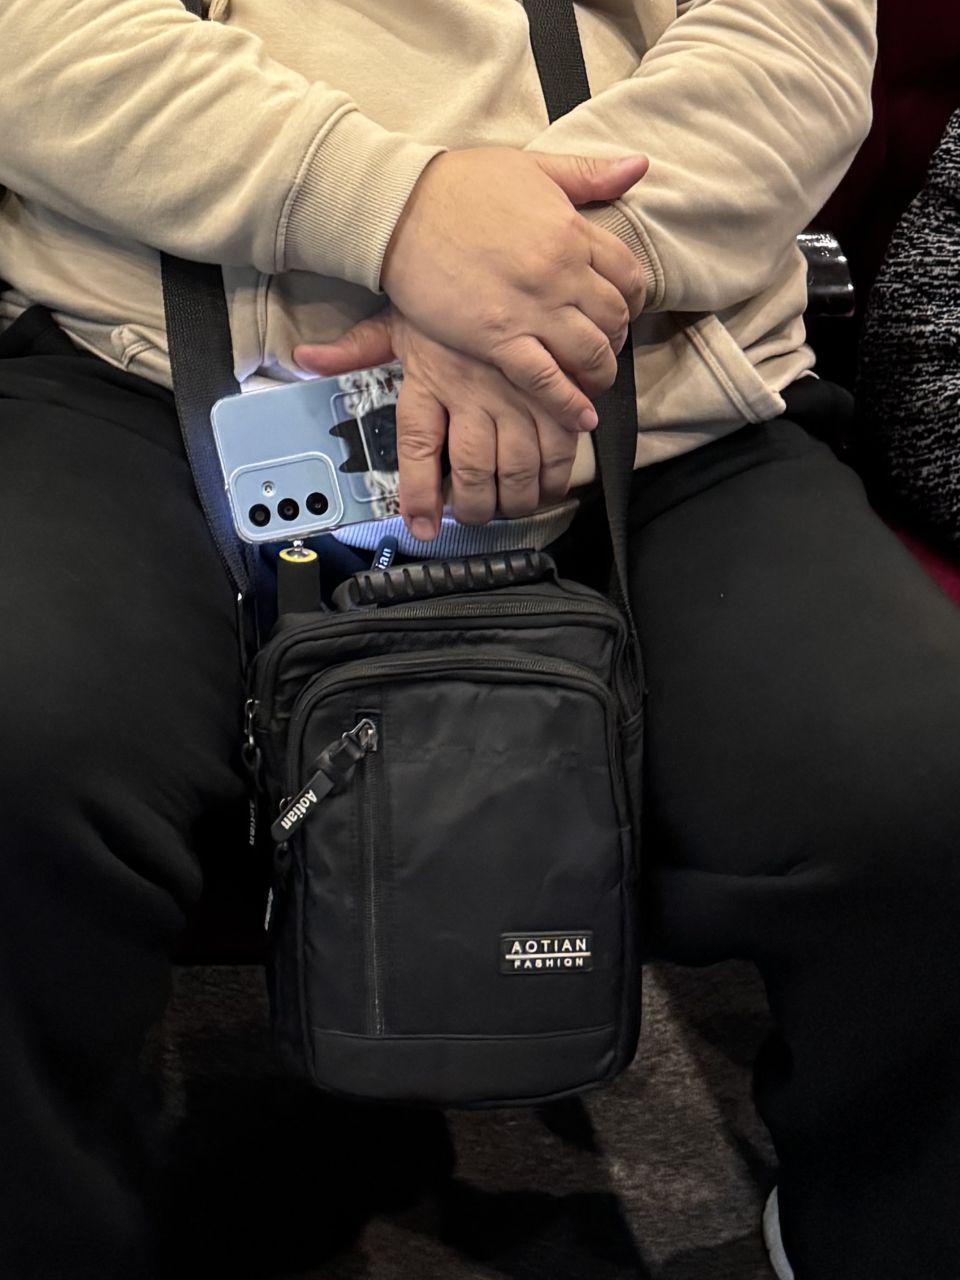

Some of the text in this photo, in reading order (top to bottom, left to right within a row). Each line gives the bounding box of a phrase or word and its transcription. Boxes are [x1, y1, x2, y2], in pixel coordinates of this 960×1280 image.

[375, 548, 392, 570] ian
[280, 789, 318, 830] Aotian
[511, 938, 587, 954] AOTIAN
[514, 957, 584, 969] FASHION
